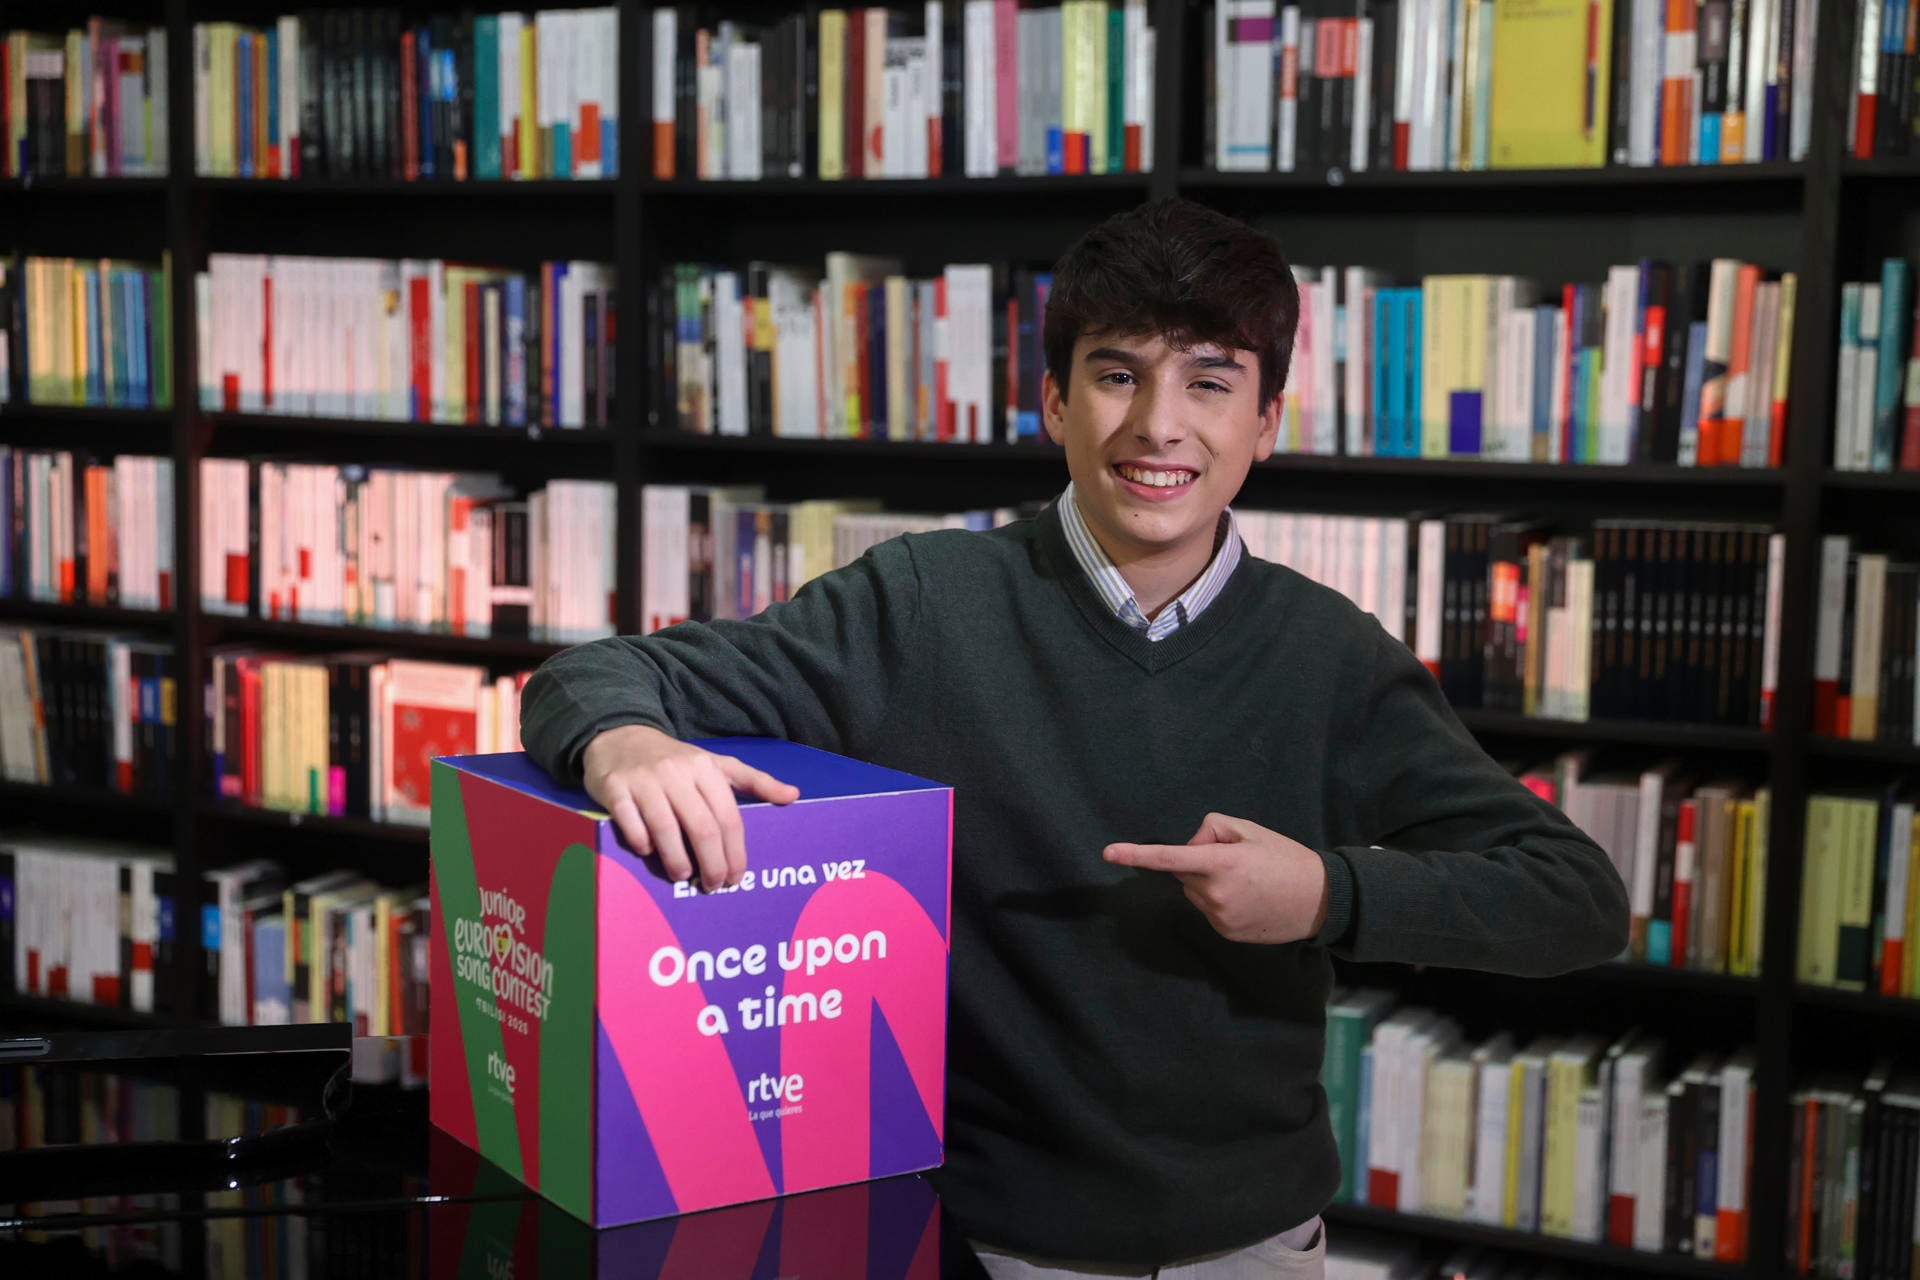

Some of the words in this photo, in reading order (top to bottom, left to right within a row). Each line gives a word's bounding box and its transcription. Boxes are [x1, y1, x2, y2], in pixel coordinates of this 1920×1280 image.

[761, 864, 817, 889] una
[822, 859, 866, 882] vez
[648, 944, 767, 987] Once
[777, 930, 887, 976] upon
[696, 1005, 729, 1037] a
[738, 985, 843, 1031] time
[487, 1050, 516, 1094] rtve
[748, 1072, 804, 1104] rtve
[760, 1109, 774, 1121] que
[774, 1105, 803, 1119] quieres
